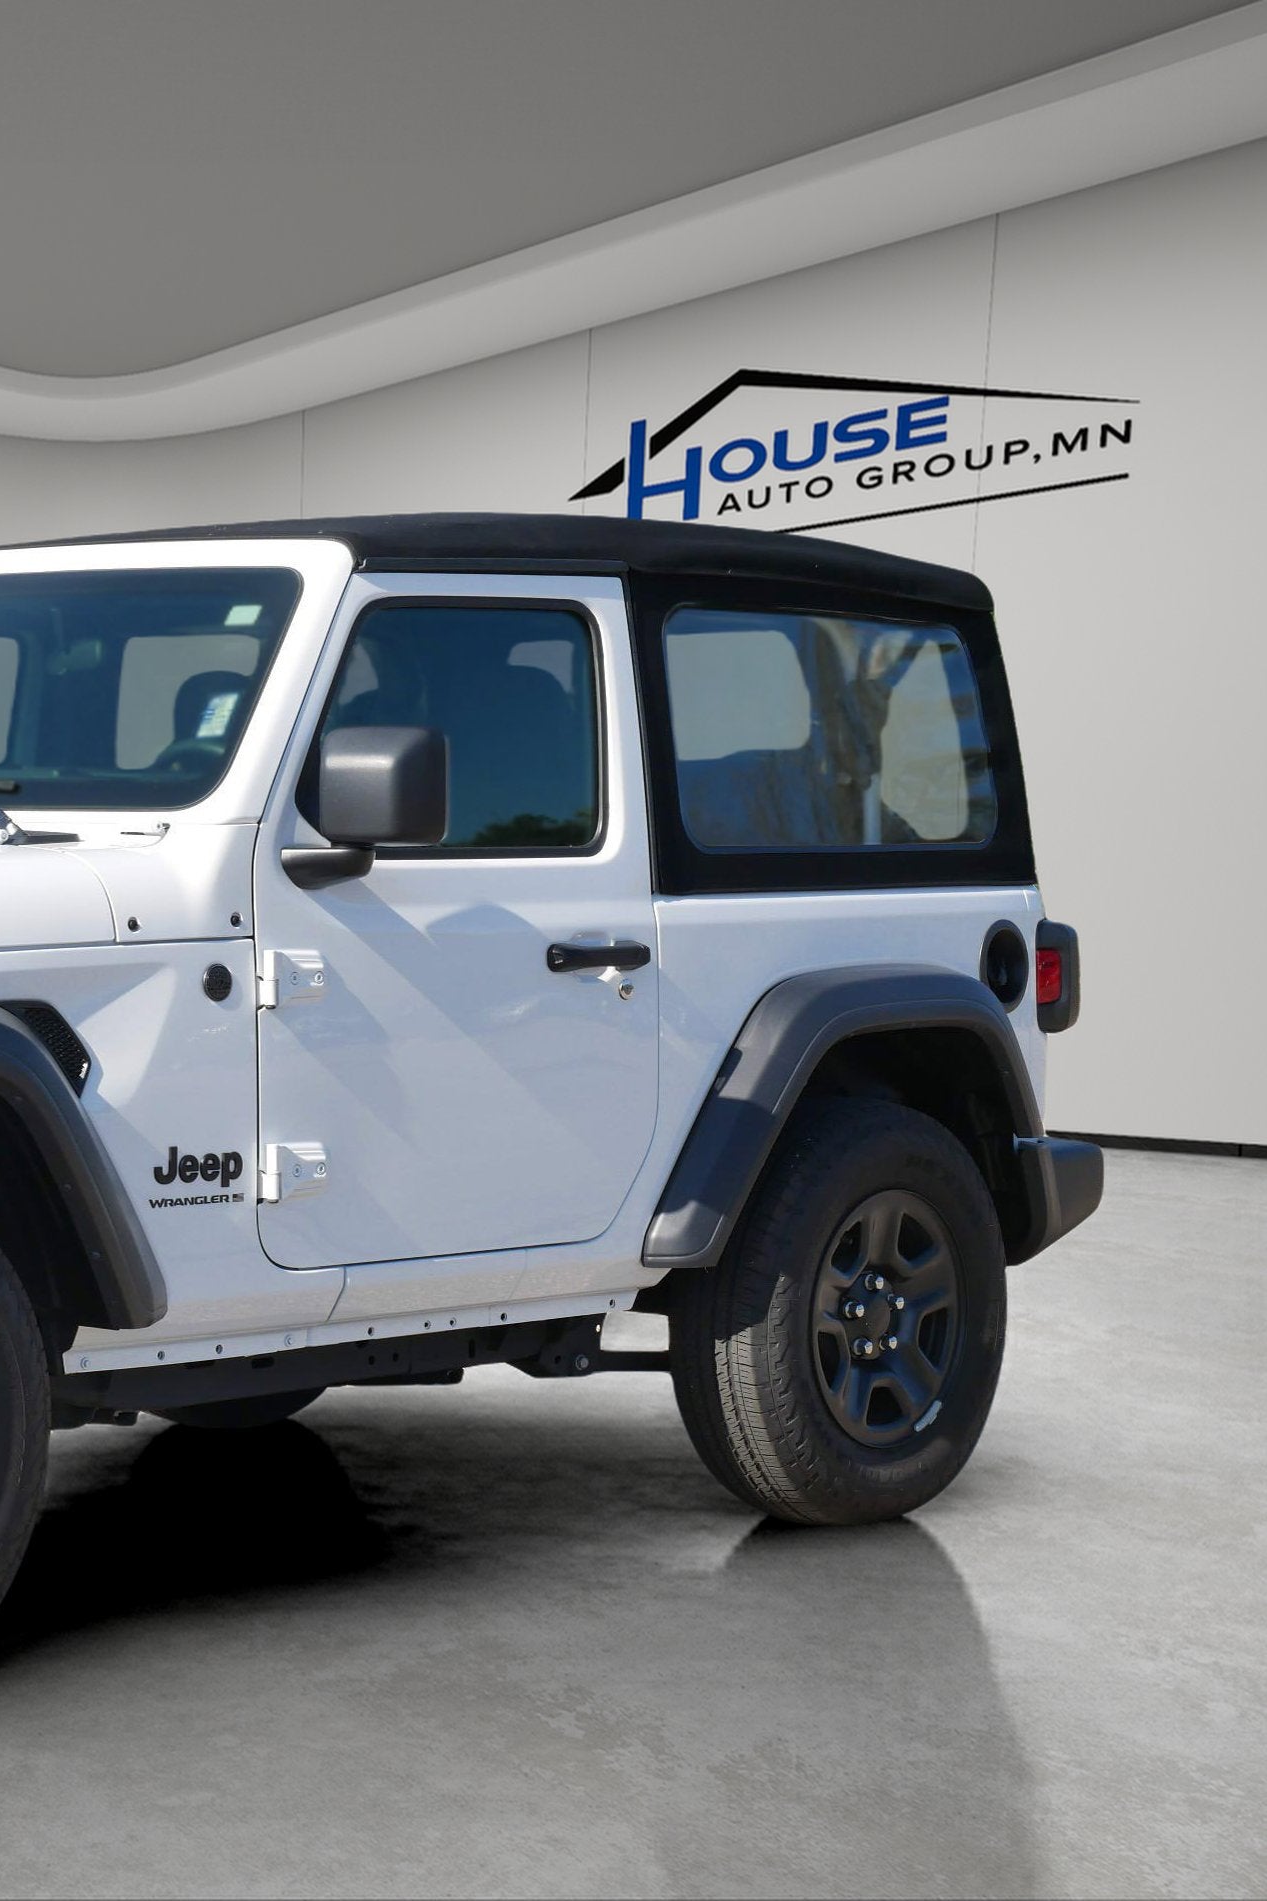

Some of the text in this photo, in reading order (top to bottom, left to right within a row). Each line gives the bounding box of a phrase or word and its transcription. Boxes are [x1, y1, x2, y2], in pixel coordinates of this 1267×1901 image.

[627, 396, 949, 520] HOUSE
[717, 475, 834, 516] AUTO
[153, 1146, 244, 1188] Jeep
[148, 1194, 230, 1209] WRANGLER
